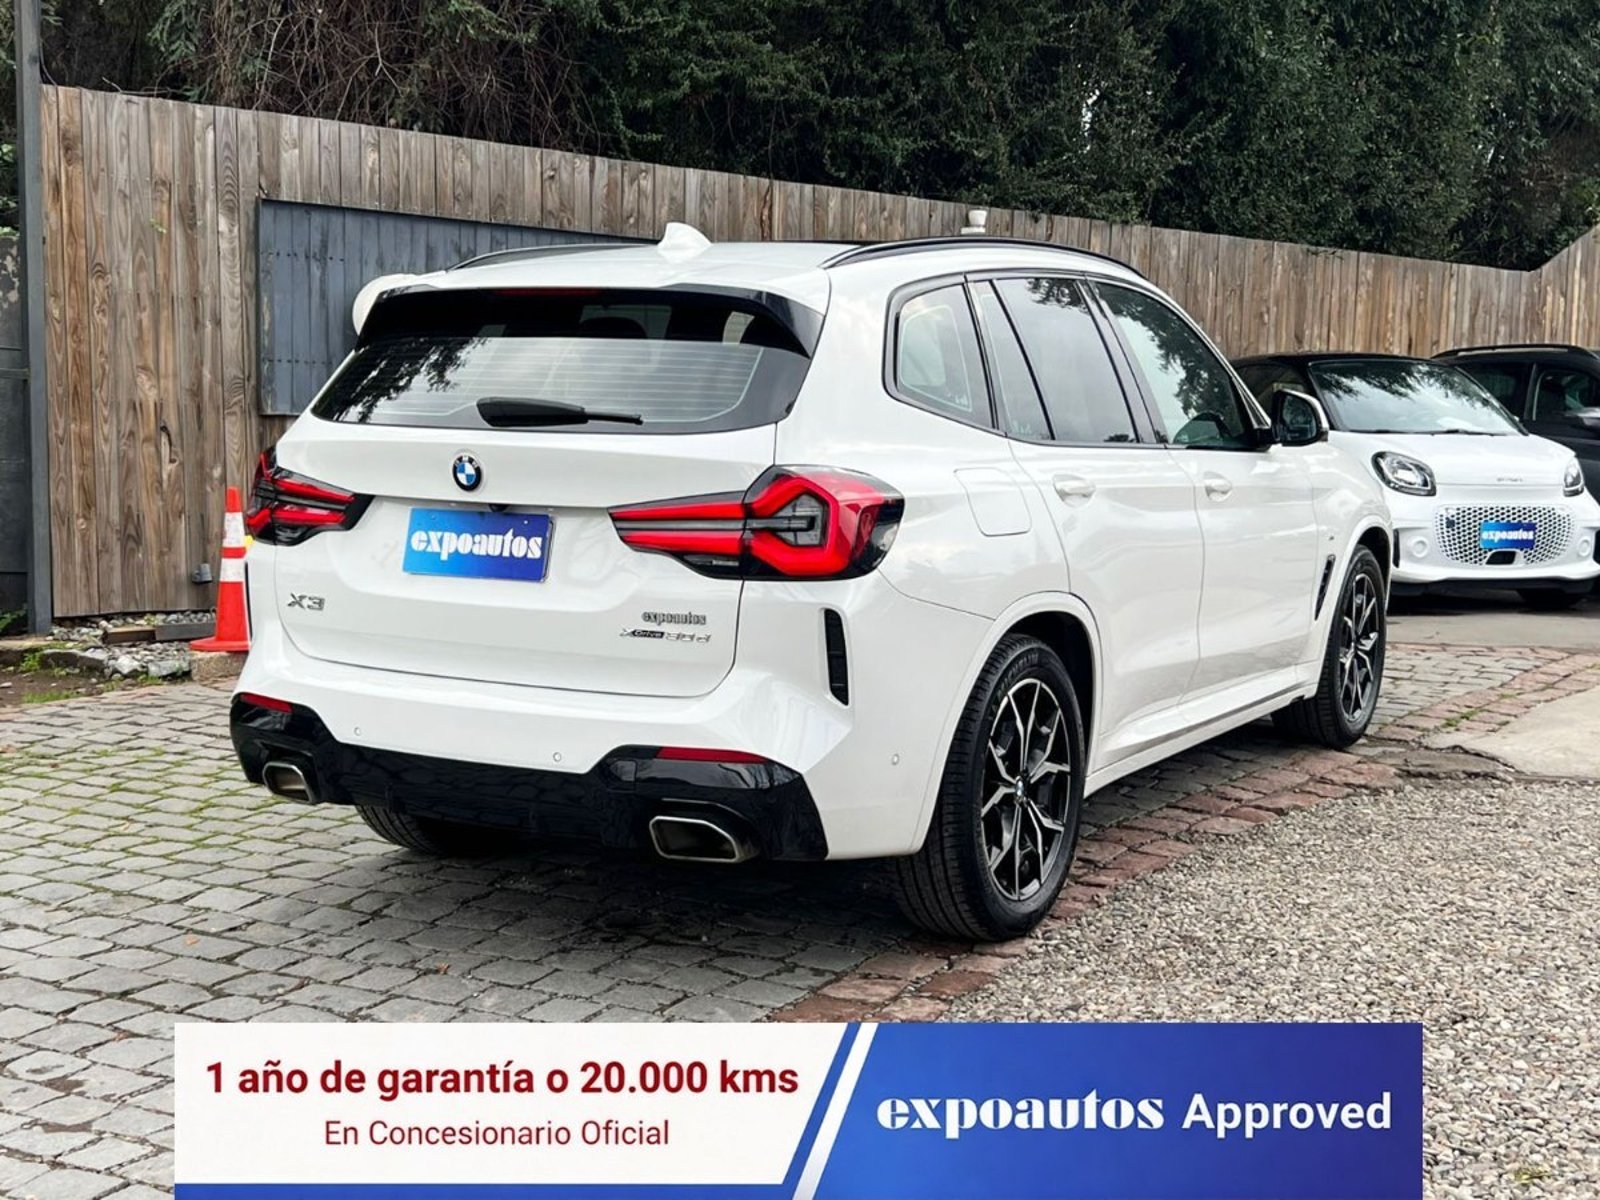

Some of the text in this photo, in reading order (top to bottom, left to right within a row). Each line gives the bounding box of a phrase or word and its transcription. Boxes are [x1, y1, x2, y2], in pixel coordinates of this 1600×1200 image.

[410, 528, 543, 561] expoautos
[287, 592, 325, 611] X3
[641, 611, 706, 626] expoautos
